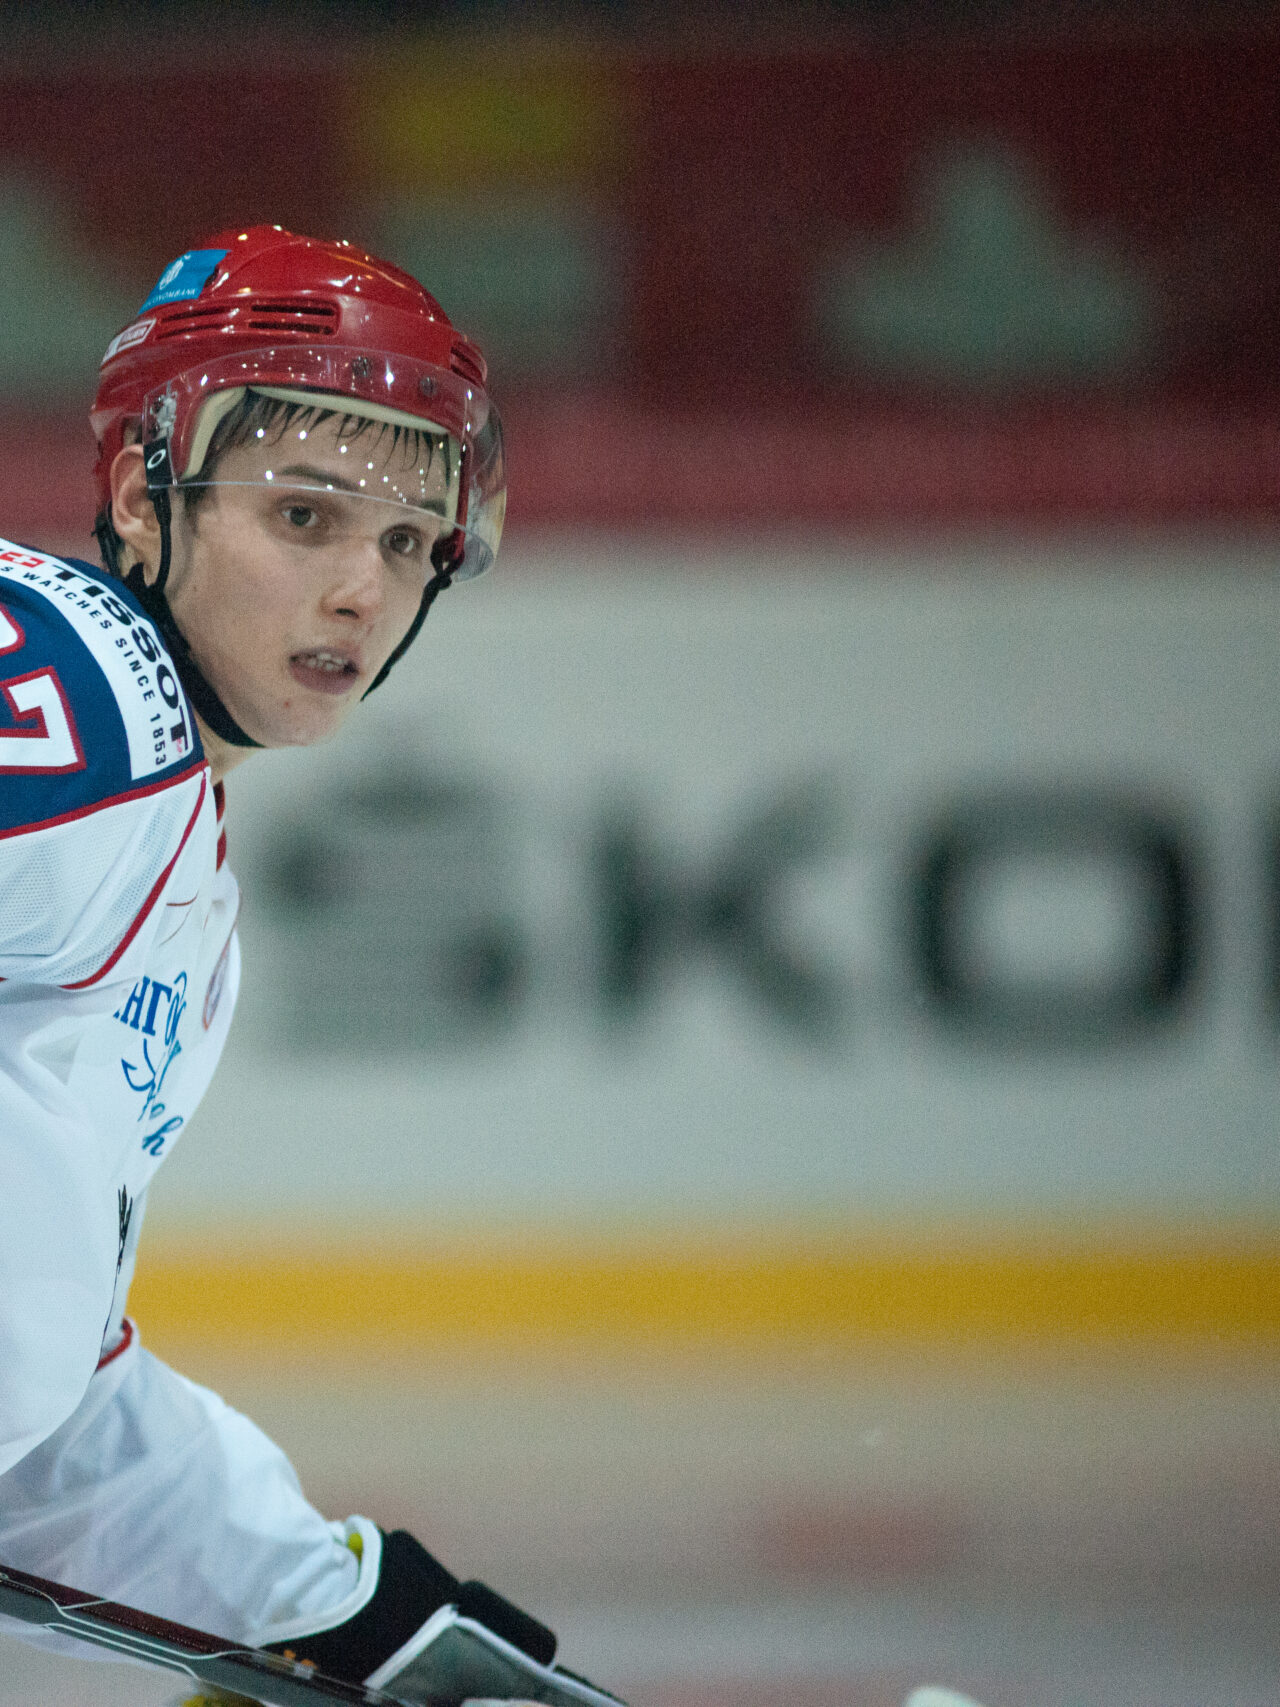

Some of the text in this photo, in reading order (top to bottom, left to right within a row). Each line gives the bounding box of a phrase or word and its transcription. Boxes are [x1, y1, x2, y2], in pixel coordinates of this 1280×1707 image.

[23, 571, 112, 630] WATCHES
[115, 637, 156, 702] SINCE
[149, 712, 168, 766] 1853
[52, 564, 189, 751] TISSOT
[255, 730, 1280, 1070] ŠKO
